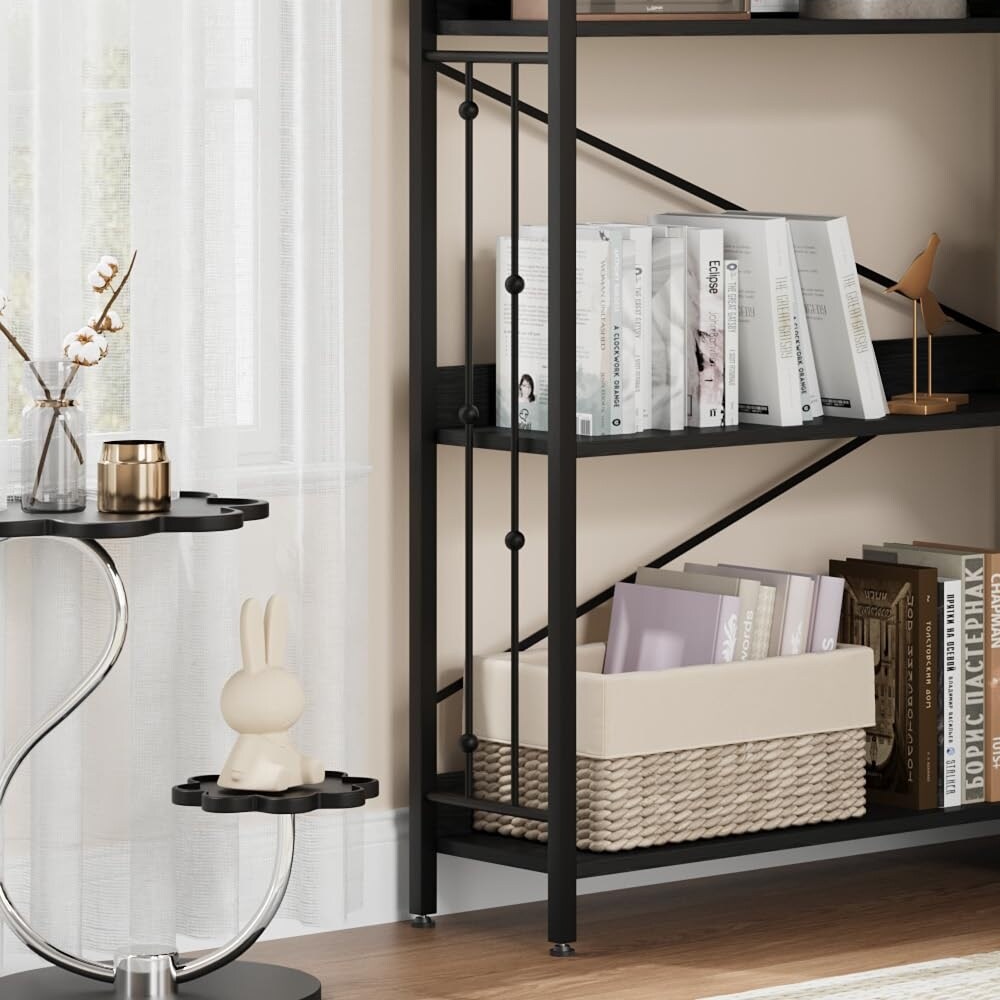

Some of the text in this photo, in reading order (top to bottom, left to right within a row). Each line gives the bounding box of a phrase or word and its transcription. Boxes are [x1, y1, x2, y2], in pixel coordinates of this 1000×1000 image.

[706, 260, 720, 294] Eclipse
[798, 367, 807, 395] ORANGE
[946, 594, 956, 672] ПРЯТКИ НА ОСЕВОЙ
[964, 566, 984, 790] БОРИС ПАСТЕРНАК
